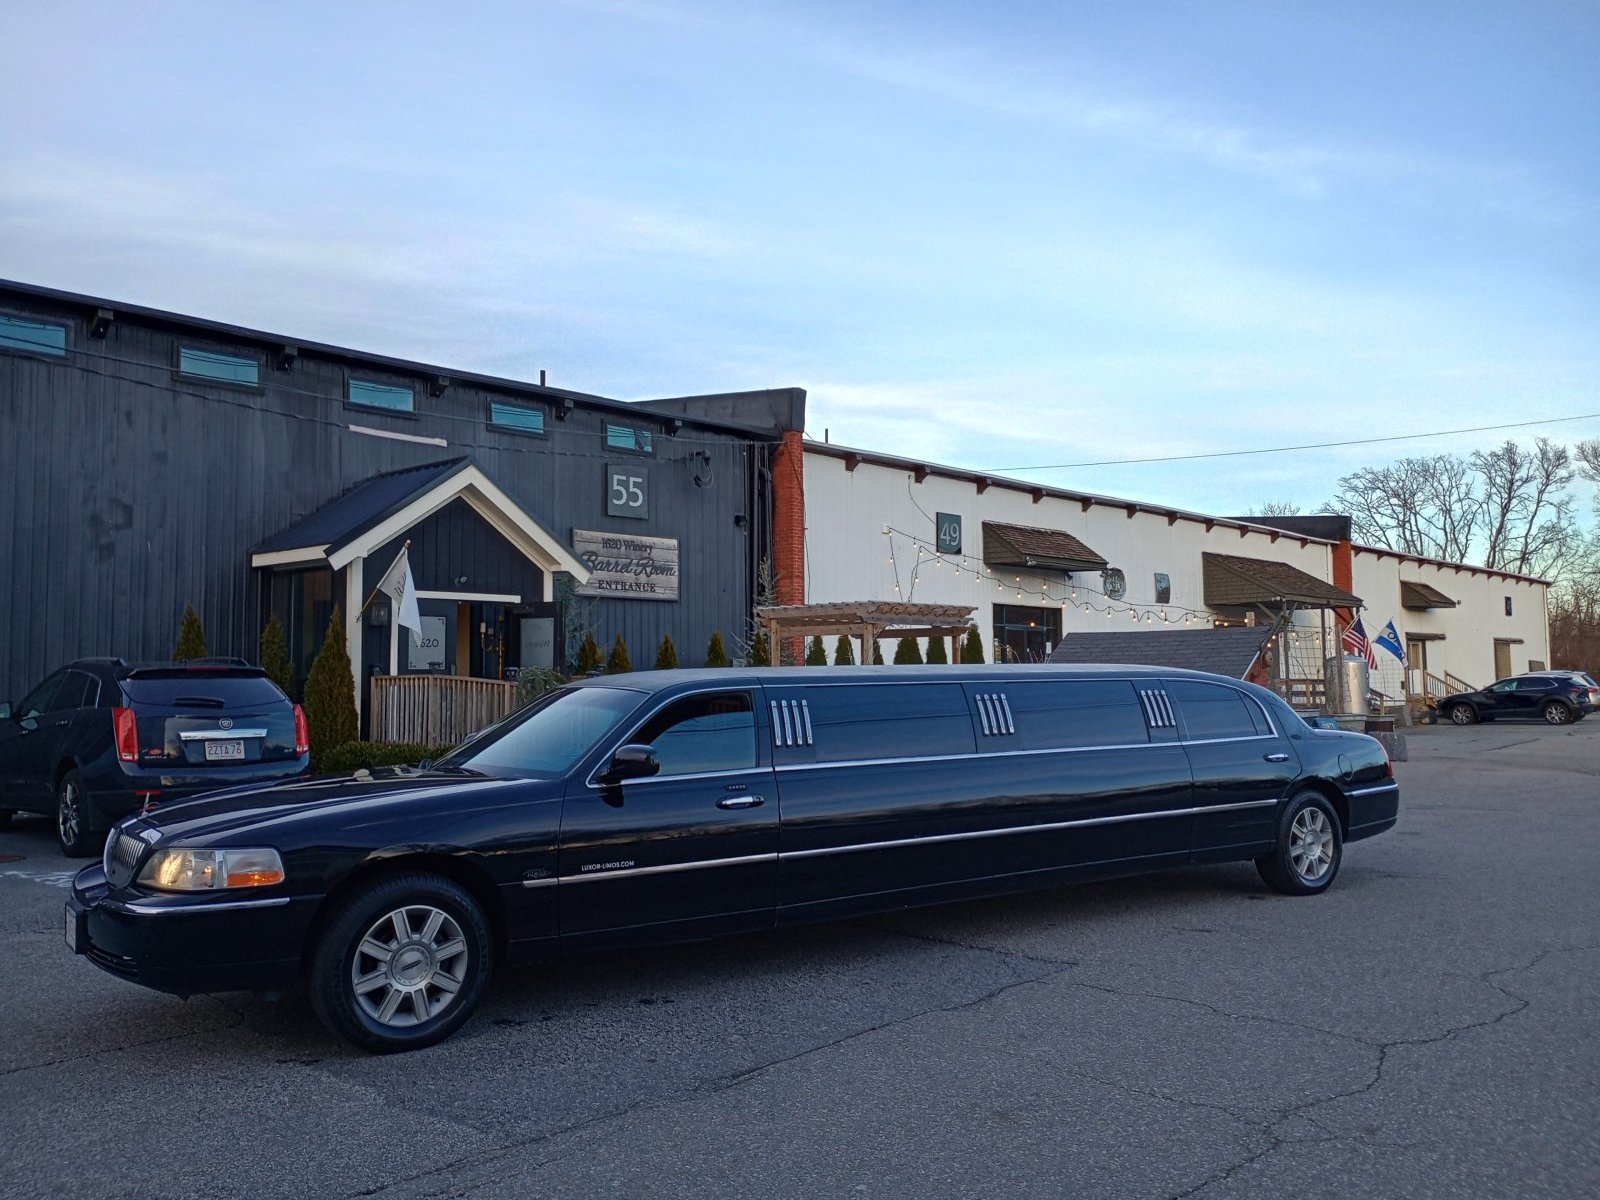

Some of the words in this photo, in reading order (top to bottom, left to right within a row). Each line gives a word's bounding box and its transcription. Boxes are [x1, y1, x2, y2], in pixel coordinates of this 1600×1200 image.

[612, 474, 644, 507] 55
[940, 523, 960, 546] 49
[602, 537, 621, 550] 1620
[622, 539, 654, 556] Winery
[581, 551, 633, 574] Barrel
[633, 557, 676, 577] Room
[598, 580, 656, 593] ENTRANCE
[416, 638, 439, 648] 620
[581, 860, 635, 870] LUXOR-LIMOS.COM
